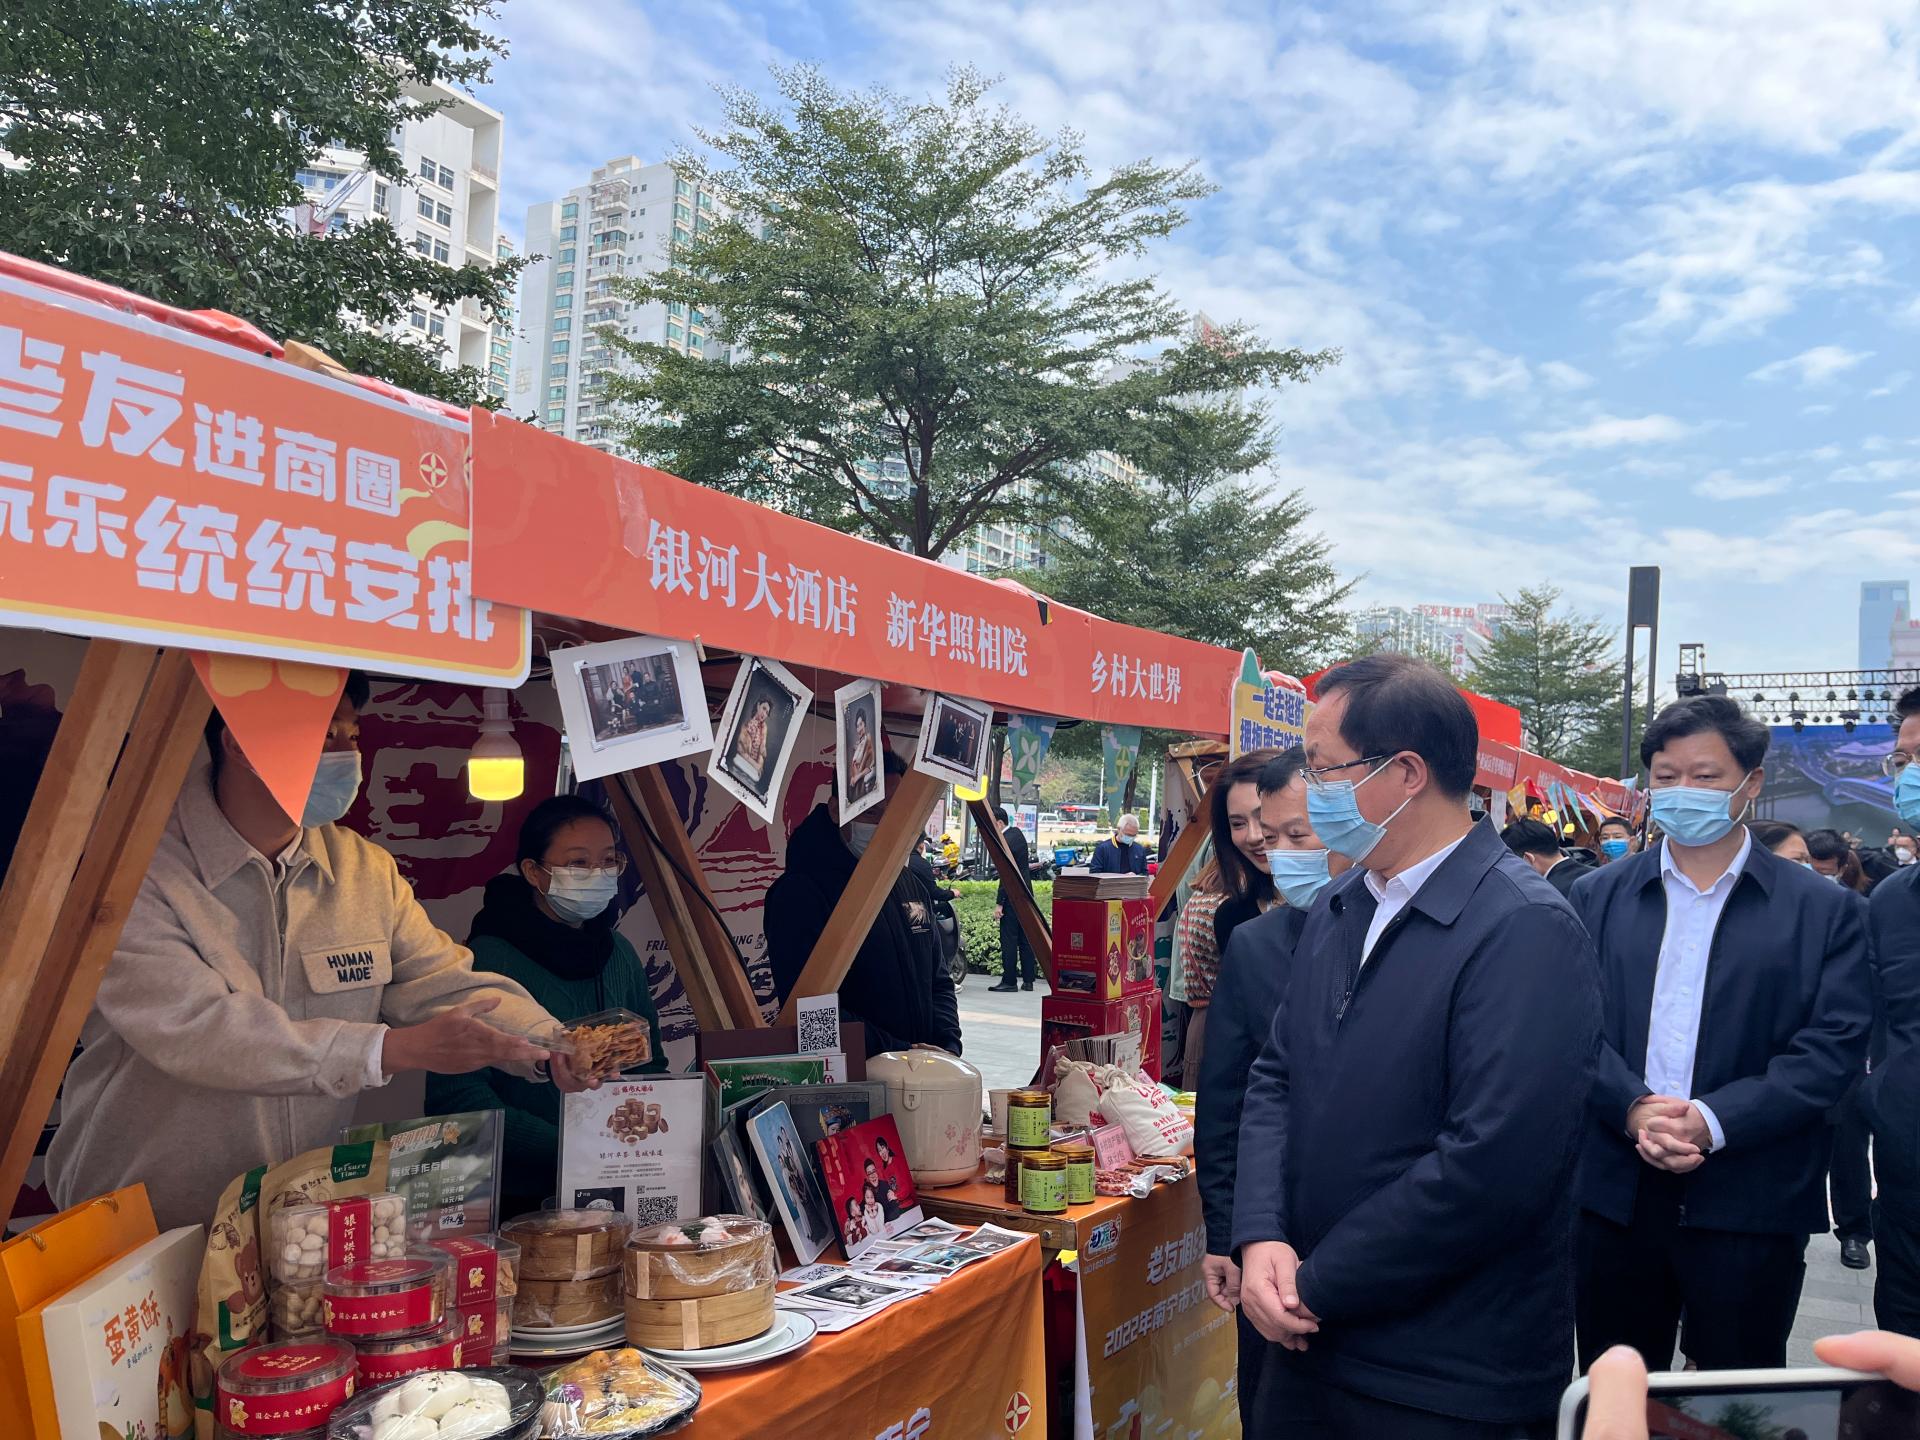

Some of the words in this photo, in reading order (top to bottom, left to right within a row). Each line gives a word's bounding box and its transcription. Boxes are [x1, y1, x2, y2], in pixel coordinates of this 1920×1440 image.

[646, 519, 857, 637] 银河大酒店
[886, 591, 1028, 677] 新华照相院
[1091, 649, 1182, 705] 乡村大世界
[326, 950, 374, 969] HUMAN
[336, 966, 372, 983] MADE
[343, 1213, 357, 1266] 银河烘焙
[104, 1290, 161, 1367] 蛋黄酥
